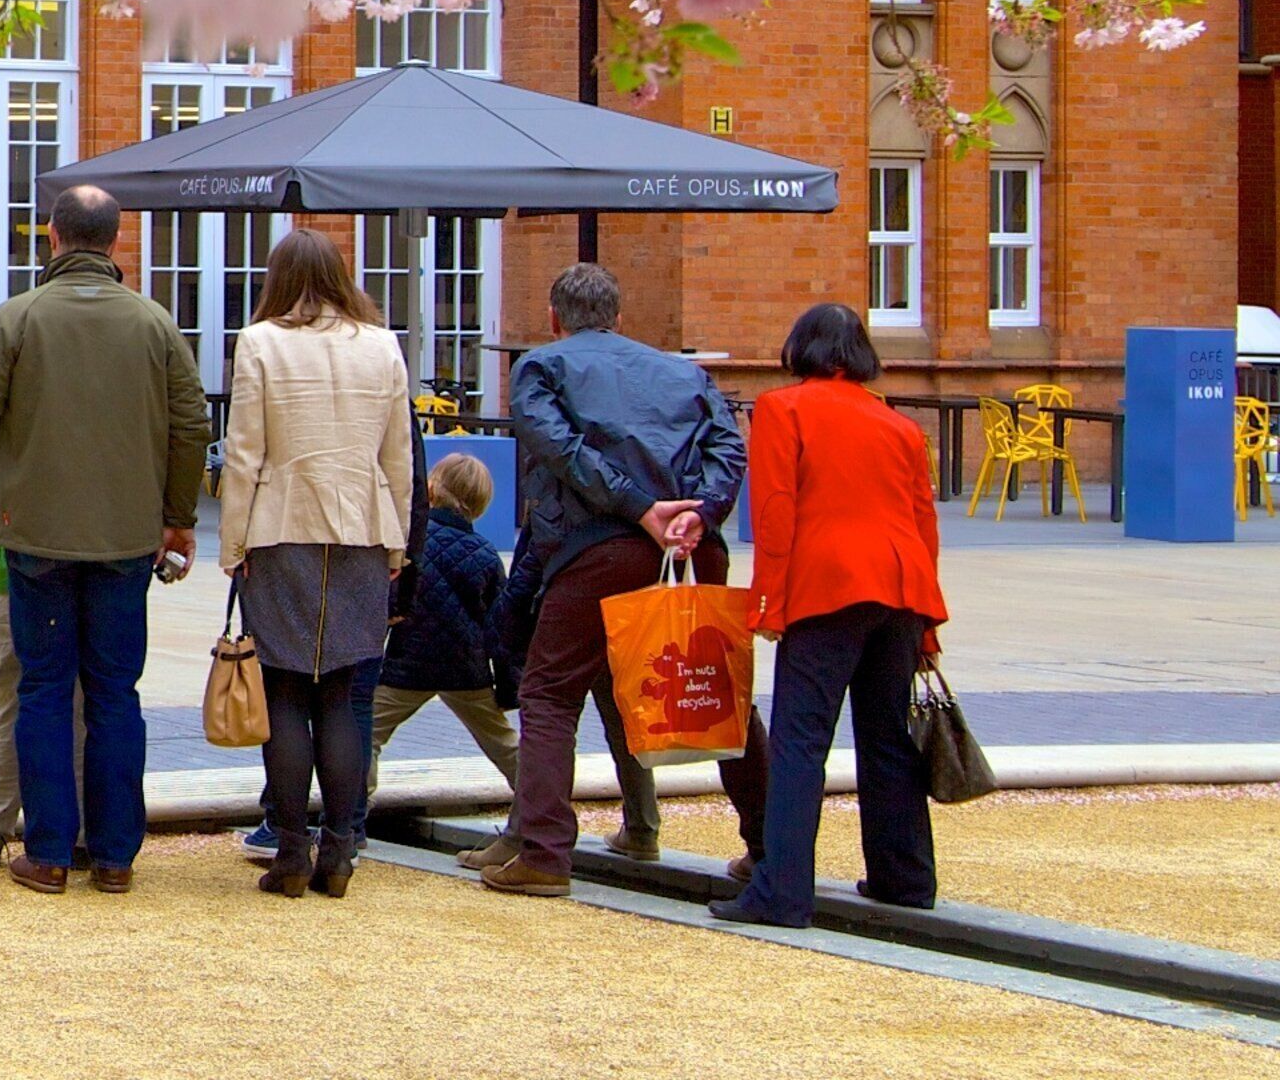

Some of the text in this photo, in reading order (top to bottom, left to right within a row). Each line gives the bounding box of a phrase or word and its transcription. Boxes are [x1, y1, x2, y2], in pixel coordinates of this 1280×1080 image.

[714, 110, 729, 132] H
[179, 174, 208, 196] CAFÉ
[244, 175, 274, 194] IKON
[627, 174, 680, 196] CAFÉ
[753, 179, 805, 198] IKON
[1190, 348, 1223, 363] CAFÉ
[1189, 368, 1224, 381] OPUS
[1188, 386, 1224, 399] IKON
[676, 661, 717, 677] I'm nuts
[685, 679, 712, 693] about
[676, 696, 722, 711] recycling
